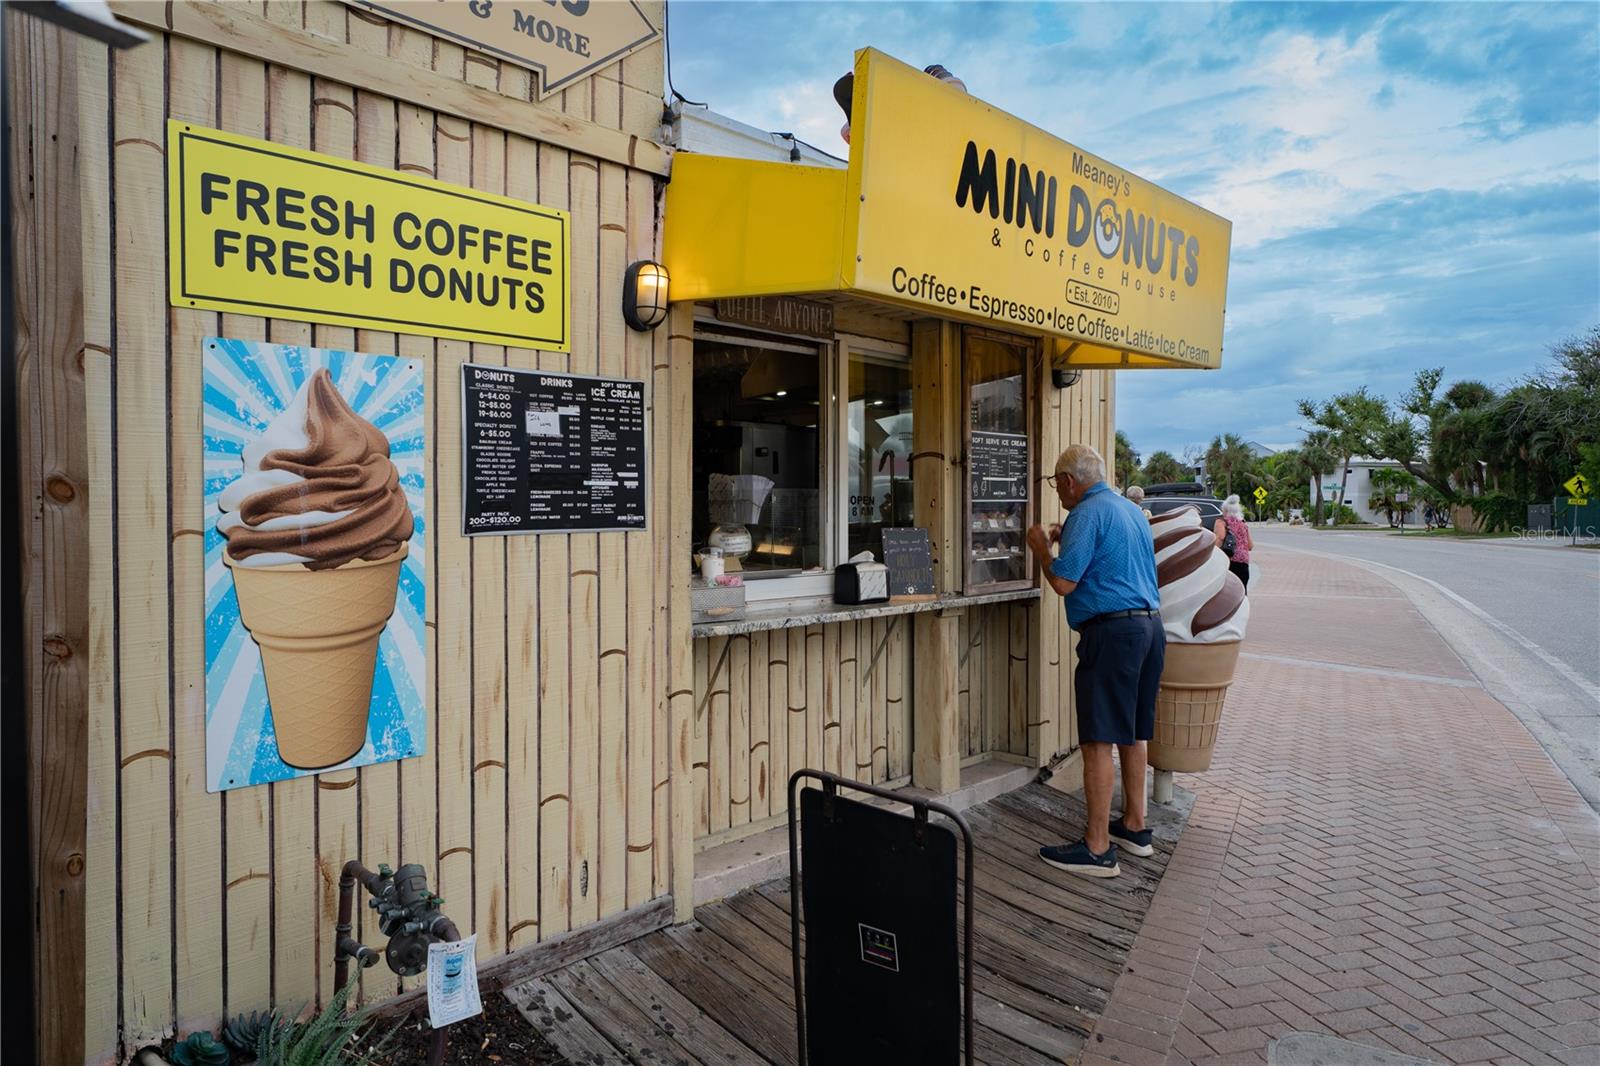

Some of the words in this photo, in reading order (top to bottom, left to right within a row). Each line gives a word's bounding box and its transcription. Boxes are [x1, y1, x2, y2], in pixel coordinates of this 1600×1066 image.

[469, 0, 493, 19] &
[512, 9, 591, 58] MORE
[1072, 151, 1131, 197] Meaney's
[201, 172, 375, 243] FRESH
[393, 212, 553, 275] COFFEE
[955, 140, 1057, 239] MINI
[1067, 184, 1201, 287] DONUTS
[214, 229, 372, 289] FRESH
[389, 258, 545, 314] DONUTS
[991, 228, 1002, 248] &
[1024, 239, 1105, 280] Coffee
[1121, 271, 1177, 302] House
[1073, 284, 1091, 305] Est.
[1092, 290, 1113, 311] 2010
[1077, 312, 1120, 343] Coffee
[1178, 339, 1210, 364] Cream
[474, 370, 515, 382] DONUTS
[540, 377, 573, 388] DRINKS
[591, 388, 606, 397] ICE
[610, 389, 640, 399] CREAM
[850, 495, 874, 506] OPEN
[852, 506, 857, 516] 8
